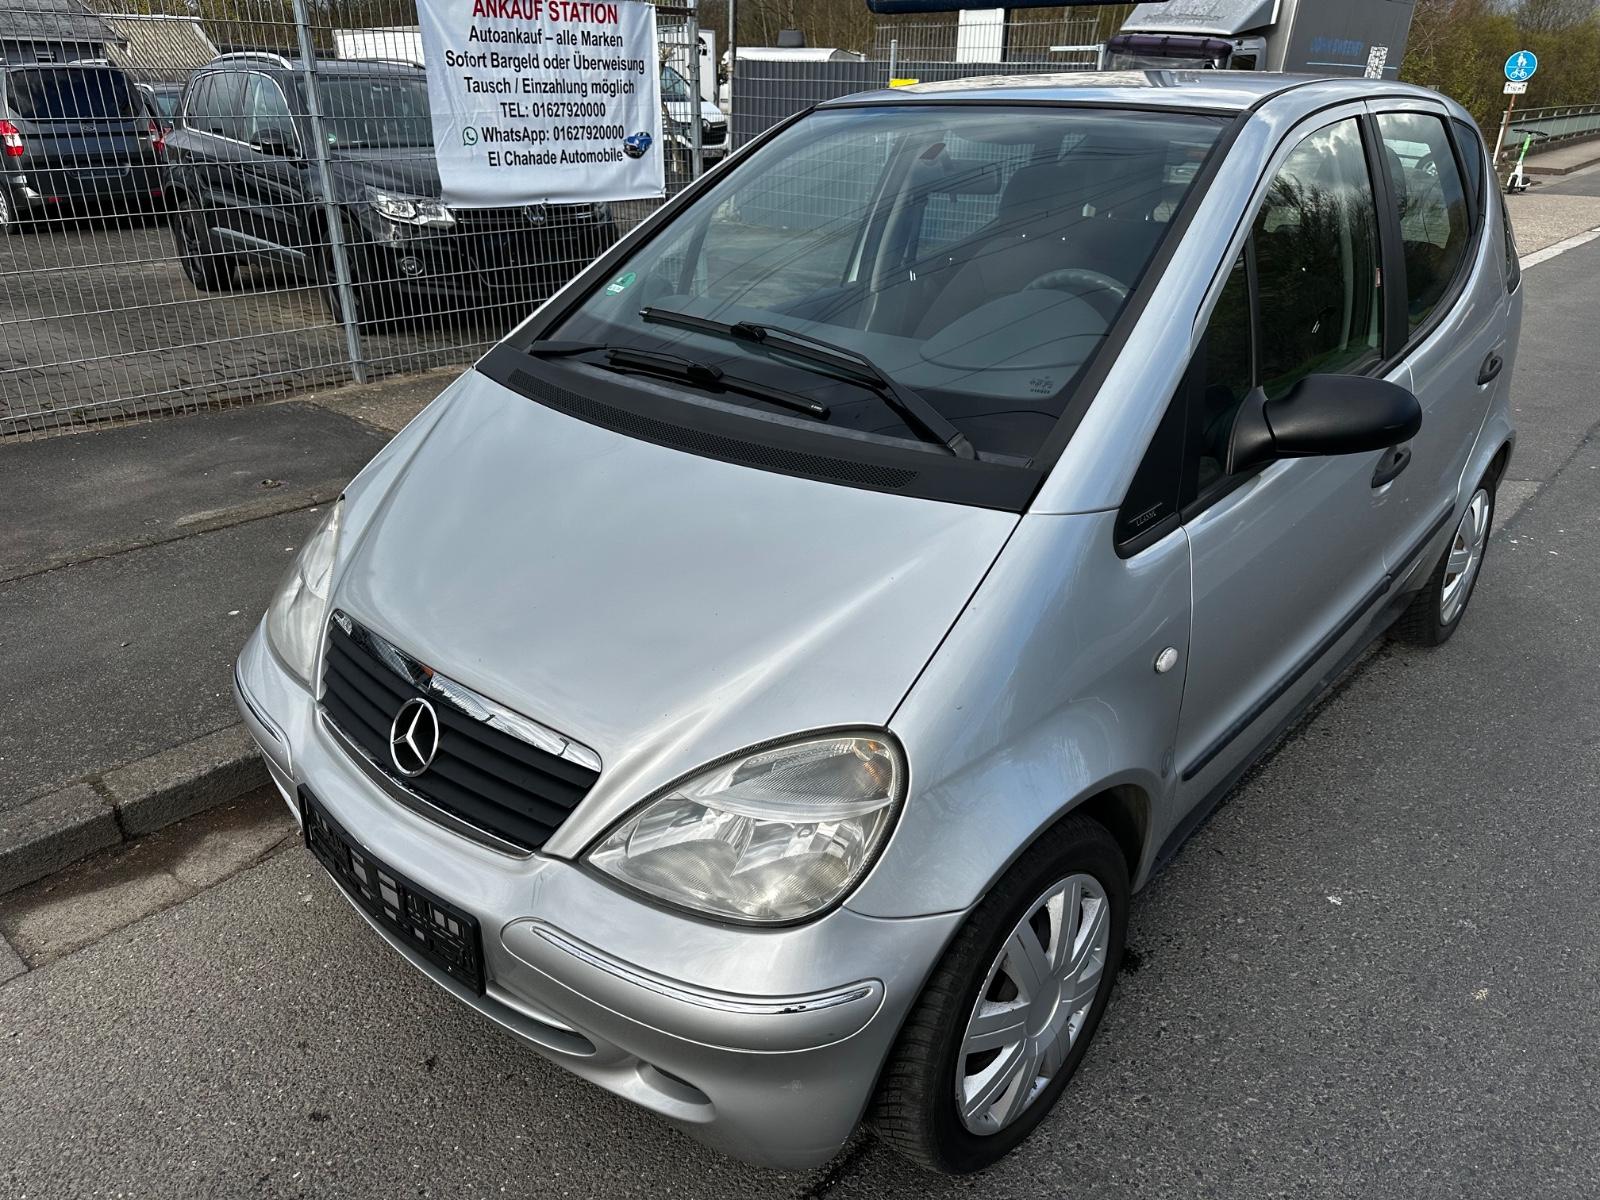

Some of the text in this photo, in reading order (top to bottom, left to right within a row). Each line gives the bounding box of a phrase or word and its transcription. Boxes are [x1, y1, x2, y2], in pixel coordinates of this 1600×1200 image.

[472, 0, 618, 24] ANKAUF STATION
[468, 25, 543, 44] Autoankauf
[556, 30, 578, 46] alle
[581, 31, 624, 47] Marken
[445, 49, 645, 75] Sofort Bargeld oder Überweisung
[464, 77, 635, 97] Tausch / Einzahlung möglich
[500, 102, 606, 118] TEL: 01627920000
[481, 125, 624, 145] WhatsApp: 01627920000
[488, 148, 624, 167] El Chahade Automobile
